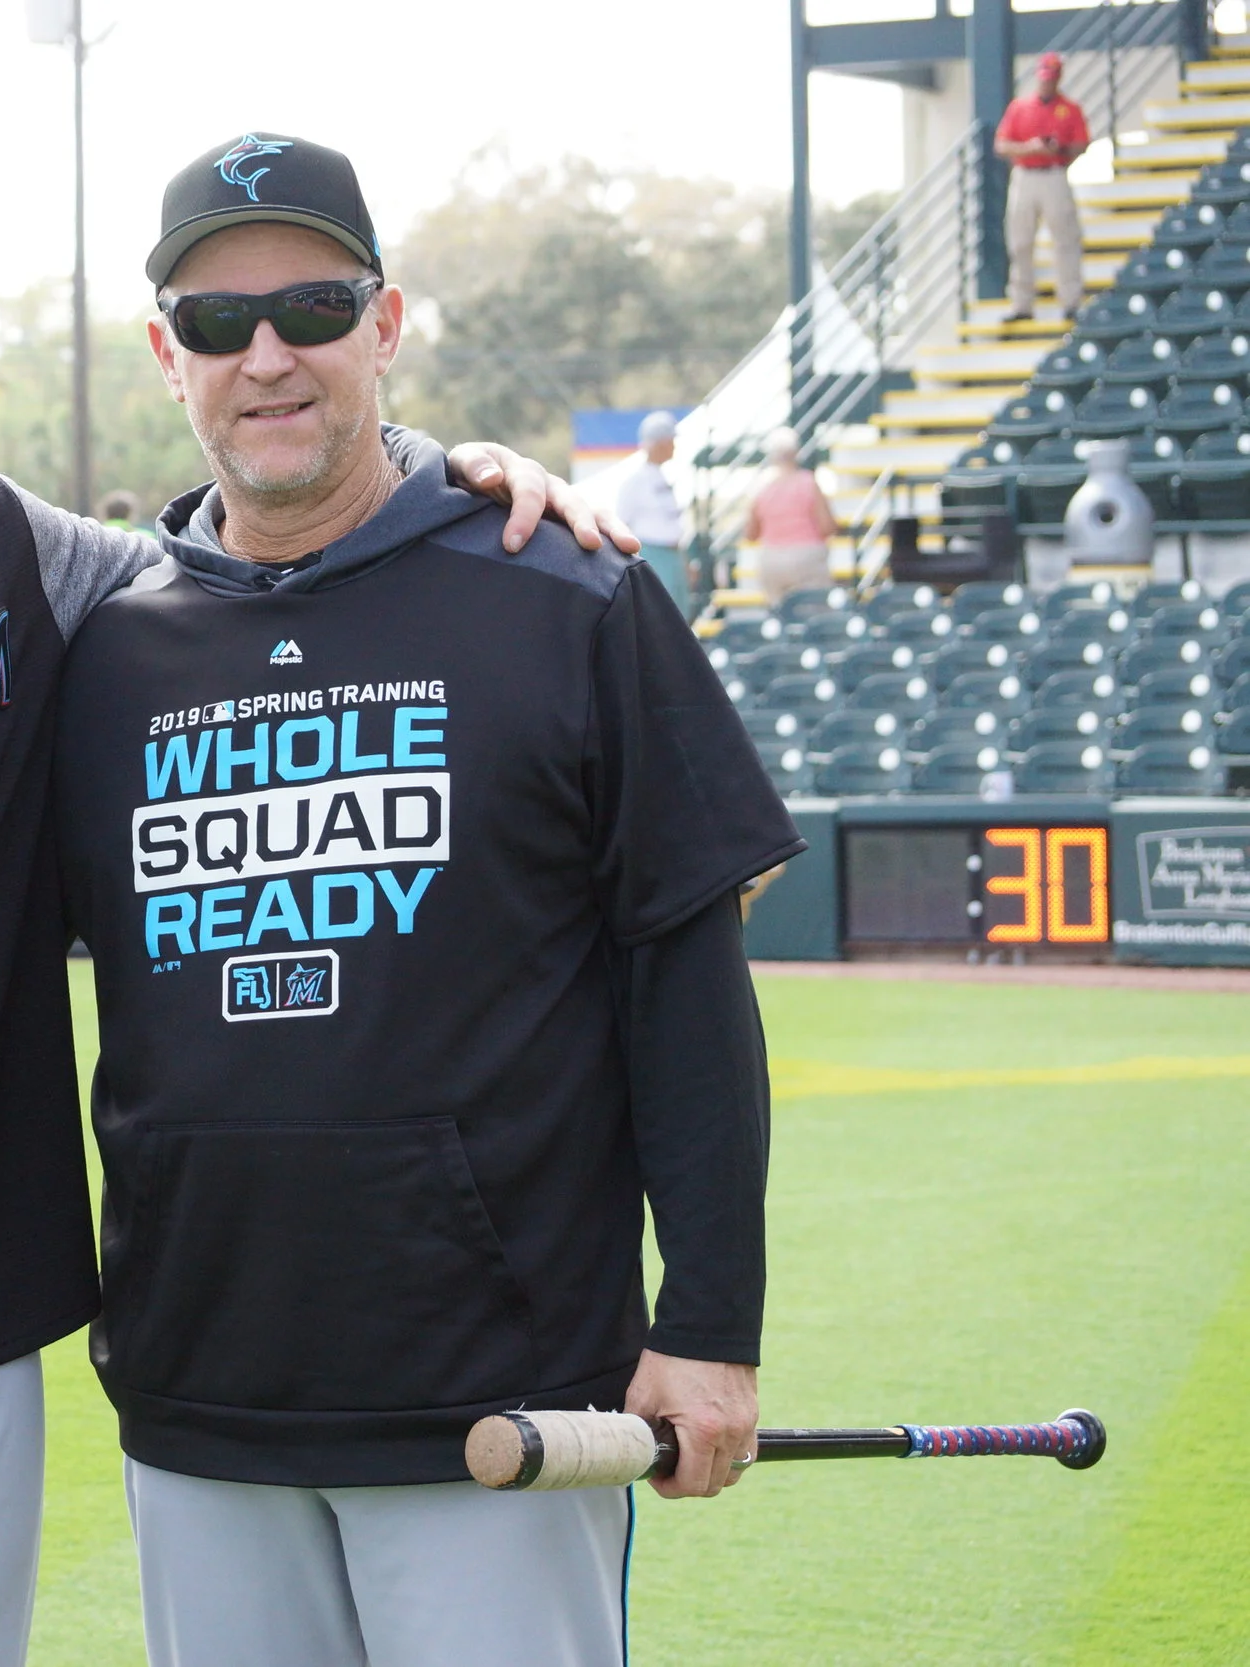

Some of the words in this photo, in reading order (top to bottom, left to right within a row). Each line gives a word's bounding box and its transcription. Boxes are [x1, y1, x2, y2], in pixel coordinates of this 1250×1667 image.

[269, 656, 303, 666] Majestic
[145, 706, 448, 799] WHOLE
[149, 707, 200, 735] 2019
[237, 689, 323, 719] SPRING
[328, 680, 445, 705] TRAINING
[138, 785, 442, 875] SQUAD
[145, 868, 437, 958] READY
[986, 828, 1109, 943] 30
[236, 980, 264, 1006] FL
